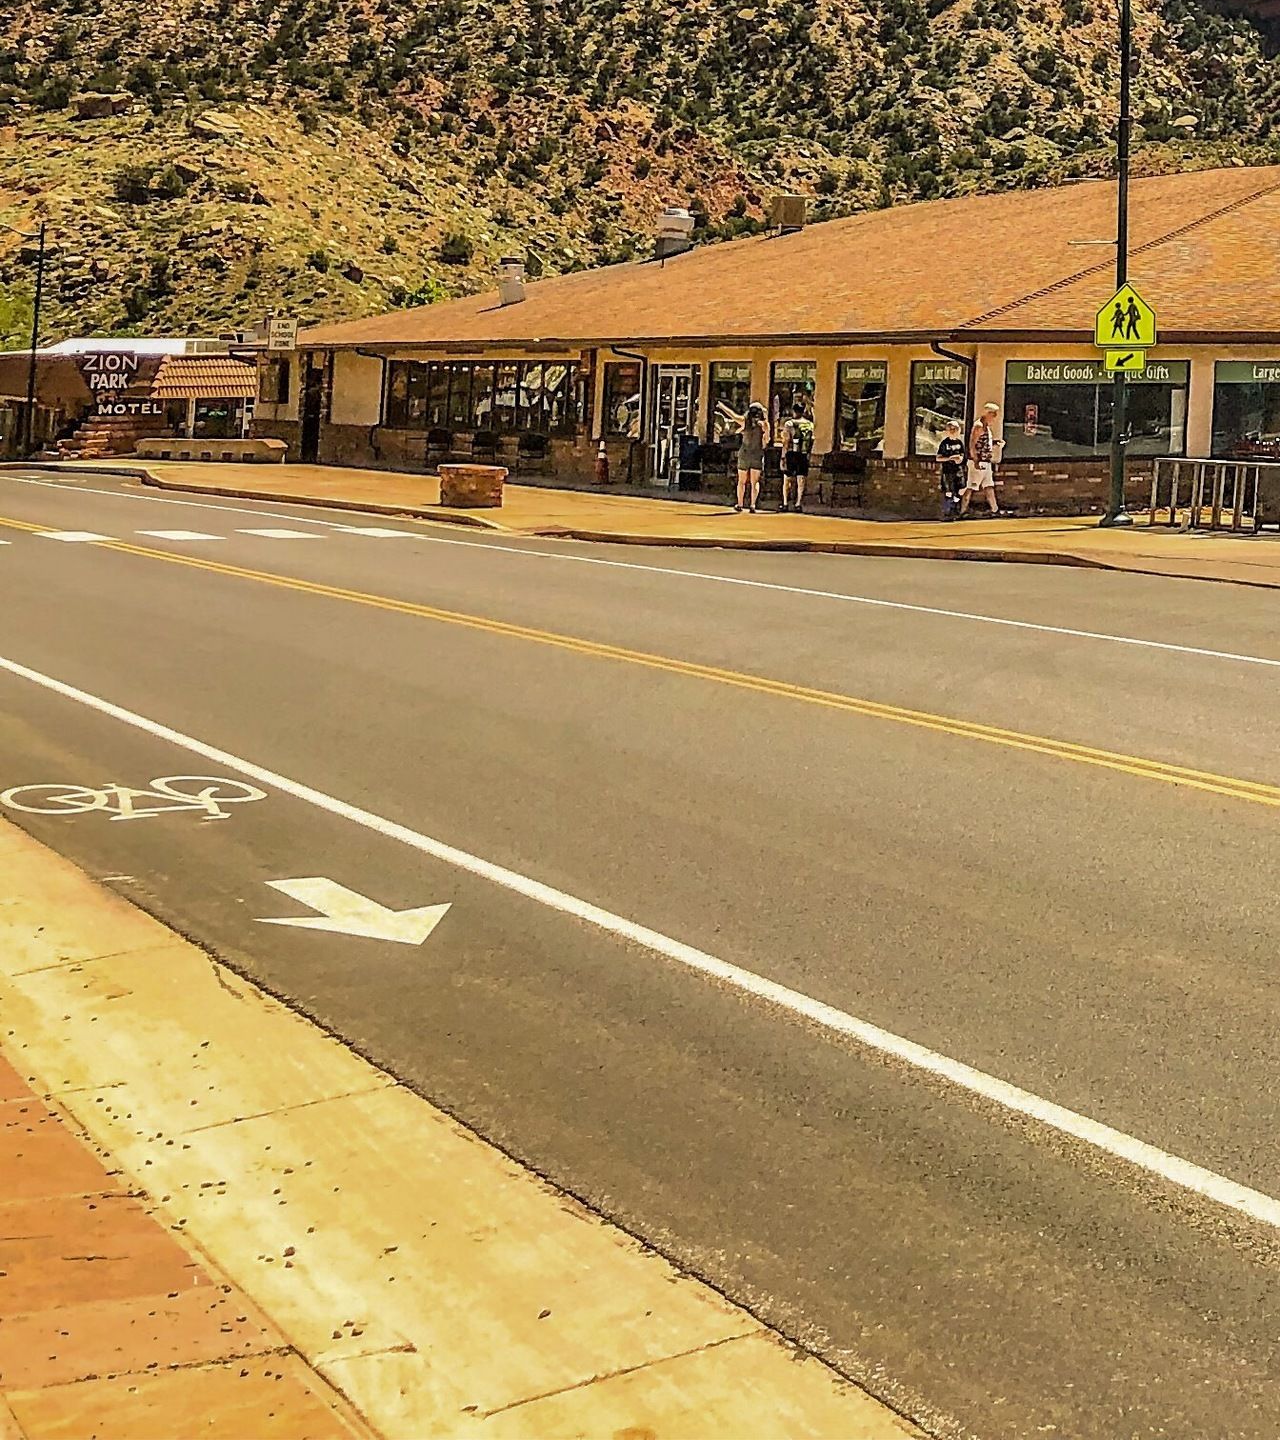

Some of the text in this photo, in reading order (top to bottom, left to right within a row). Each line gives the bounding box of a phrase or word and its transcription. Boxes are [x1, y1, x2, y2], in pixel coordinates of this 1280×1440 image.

[83, 354, 138, 371] ZION
[1027, 365, 1060, 380] Baked
[1063, 365, 1094, 380] Goods
[1146, 364, 1169, 380] Gifts
[1252, 365, 1280, 381] Large
[90, 372, 128, 389] PARK
[98, 403, 163, 415] MOTEL
